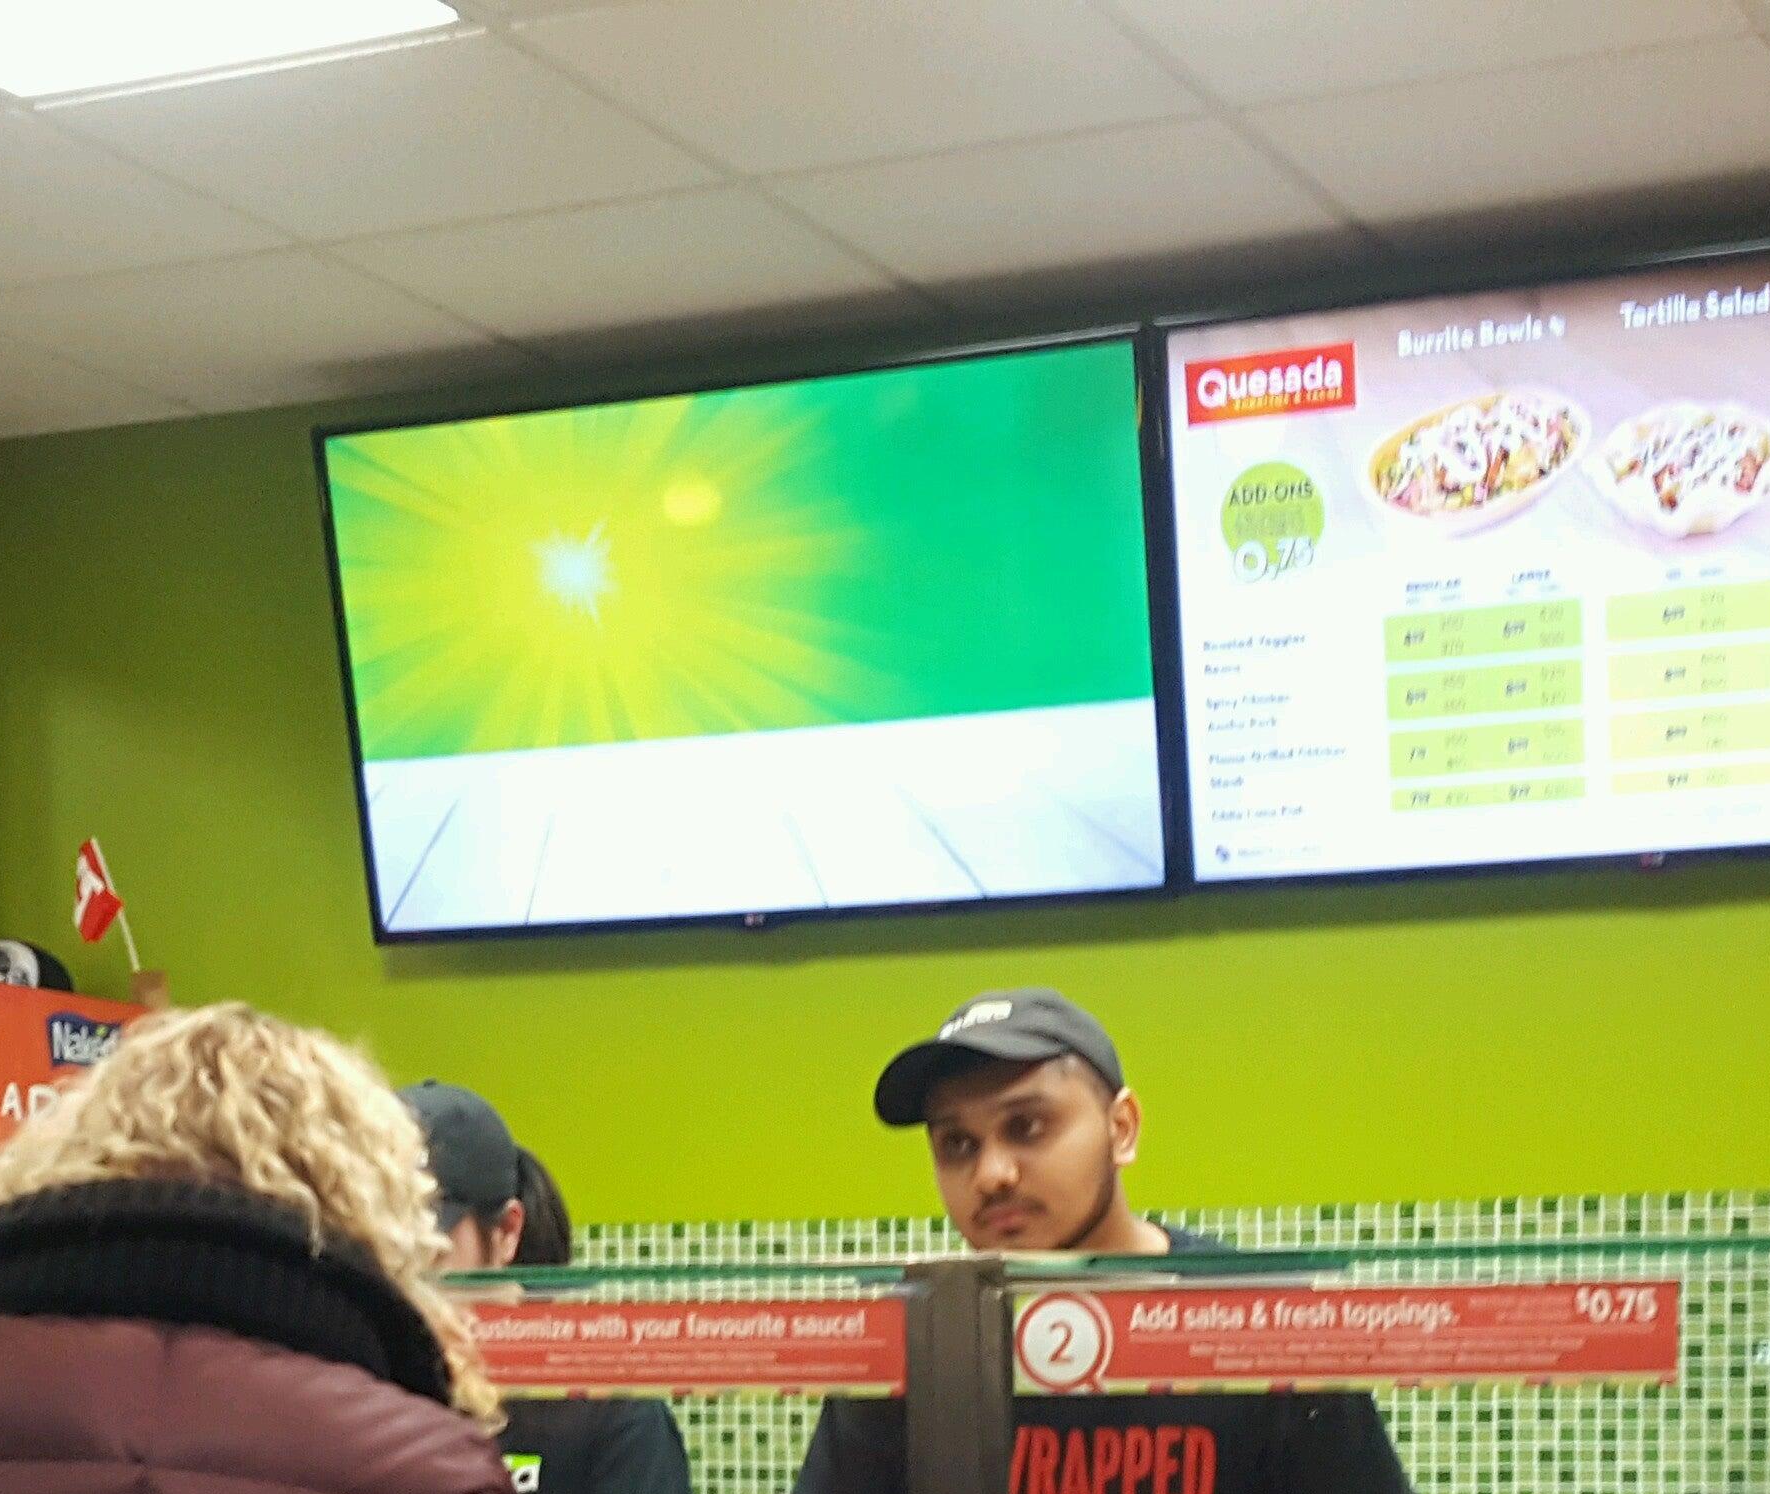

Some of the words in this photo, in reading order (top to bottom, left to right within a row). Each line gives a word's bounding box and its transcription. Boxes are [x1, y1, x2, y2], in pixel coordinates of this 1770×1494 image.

[1620, 293, 1701, 329] Tortilla
[1397, 324, 1474, 359] Burrito
[1479, 315, 1545, 351] Bowls
[1197, 355, 1343, 410] Quesada
[580, 1312, 627, 1342] with
[631, 1316, 681, 1345] your
[687, 1310, 785, 1340] favourite
[791, 1310, 866, 1339] sauce!
[1129, 1301, 1179, 1332] Add
[1183, 1301, 1244, 1331] salsa
[1249, 1302, 1268, 1331] &
[1273, 1297, 1336, 1330] fresh
[1340, 1296, 1460, 1334] toppings.
[1047, 1321, 1075, 1364] 2
